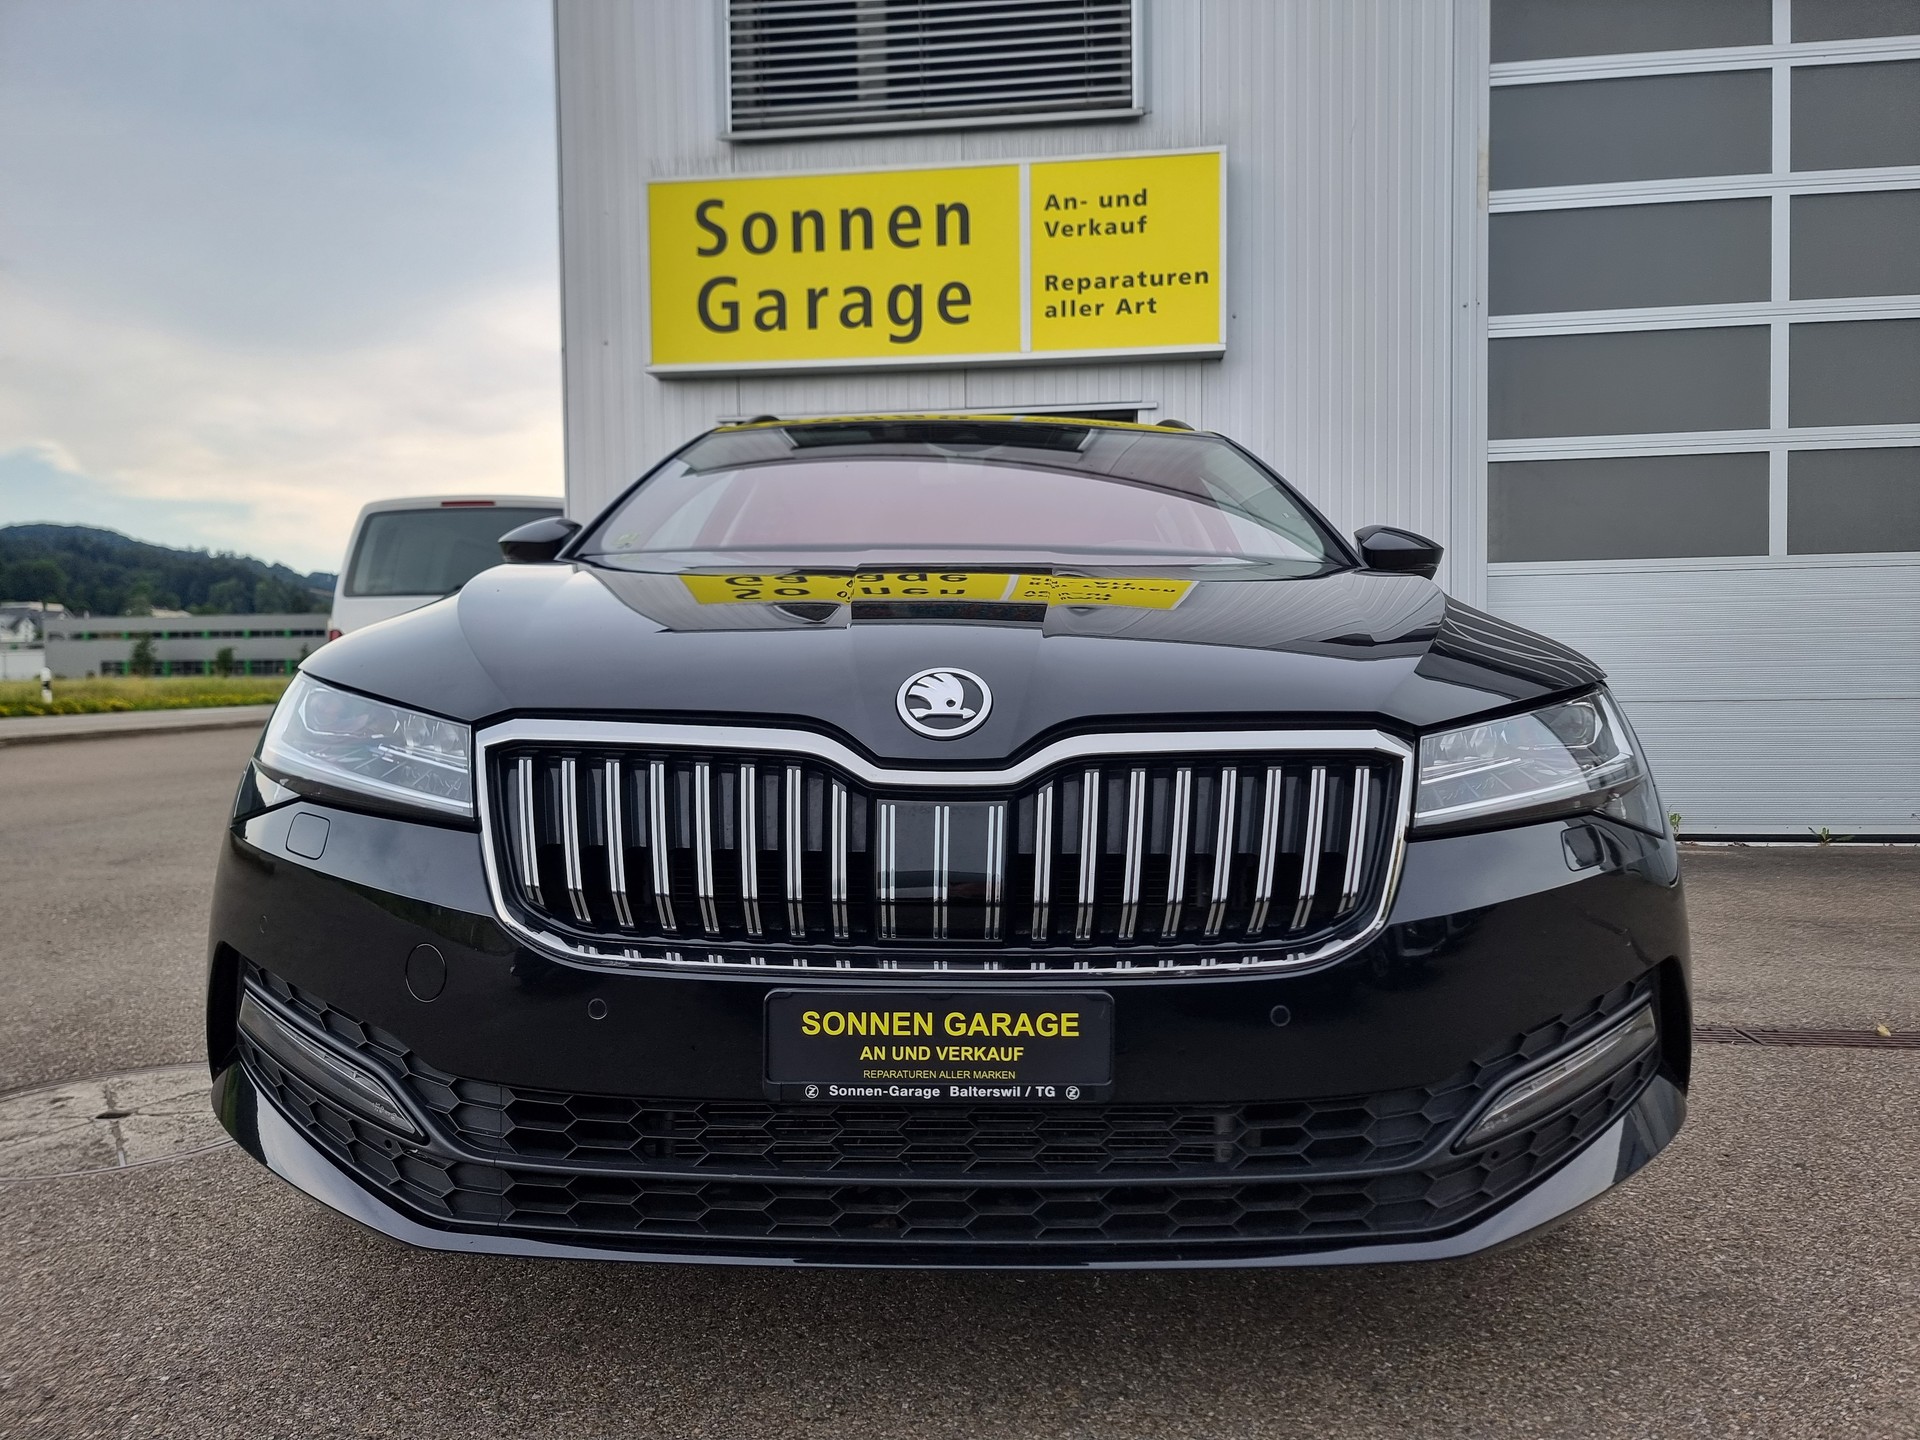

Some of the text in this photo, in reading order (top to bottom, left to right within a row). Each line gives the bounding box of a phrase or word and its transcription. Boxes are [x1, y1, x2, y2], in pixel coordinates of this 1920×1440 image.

[1044, 188, 1147, 211] An- und
[695, 198, 970, 257] Sonnen
[1044, 215, 1148, 238] Verkauf
[1044, 268, 1209, 294] Reparaturen
[697, 276, 972, 343] Garage
[1044, 297, 1157, 319] aller Art
[801, 1011, 1080, 1037] SONNEN GARAGE
[859, 1046, 1024, 1062] AN UND VERKAUF
[863, 1069, 1016, 1080] REPARATUREN ALLER MARKEN
[828, 1085, 940, 1099] Sonnen-Garage
[949, 1086, 1021, 1098] Balterswil
[1035, 1086, 1056, 1098] TG
